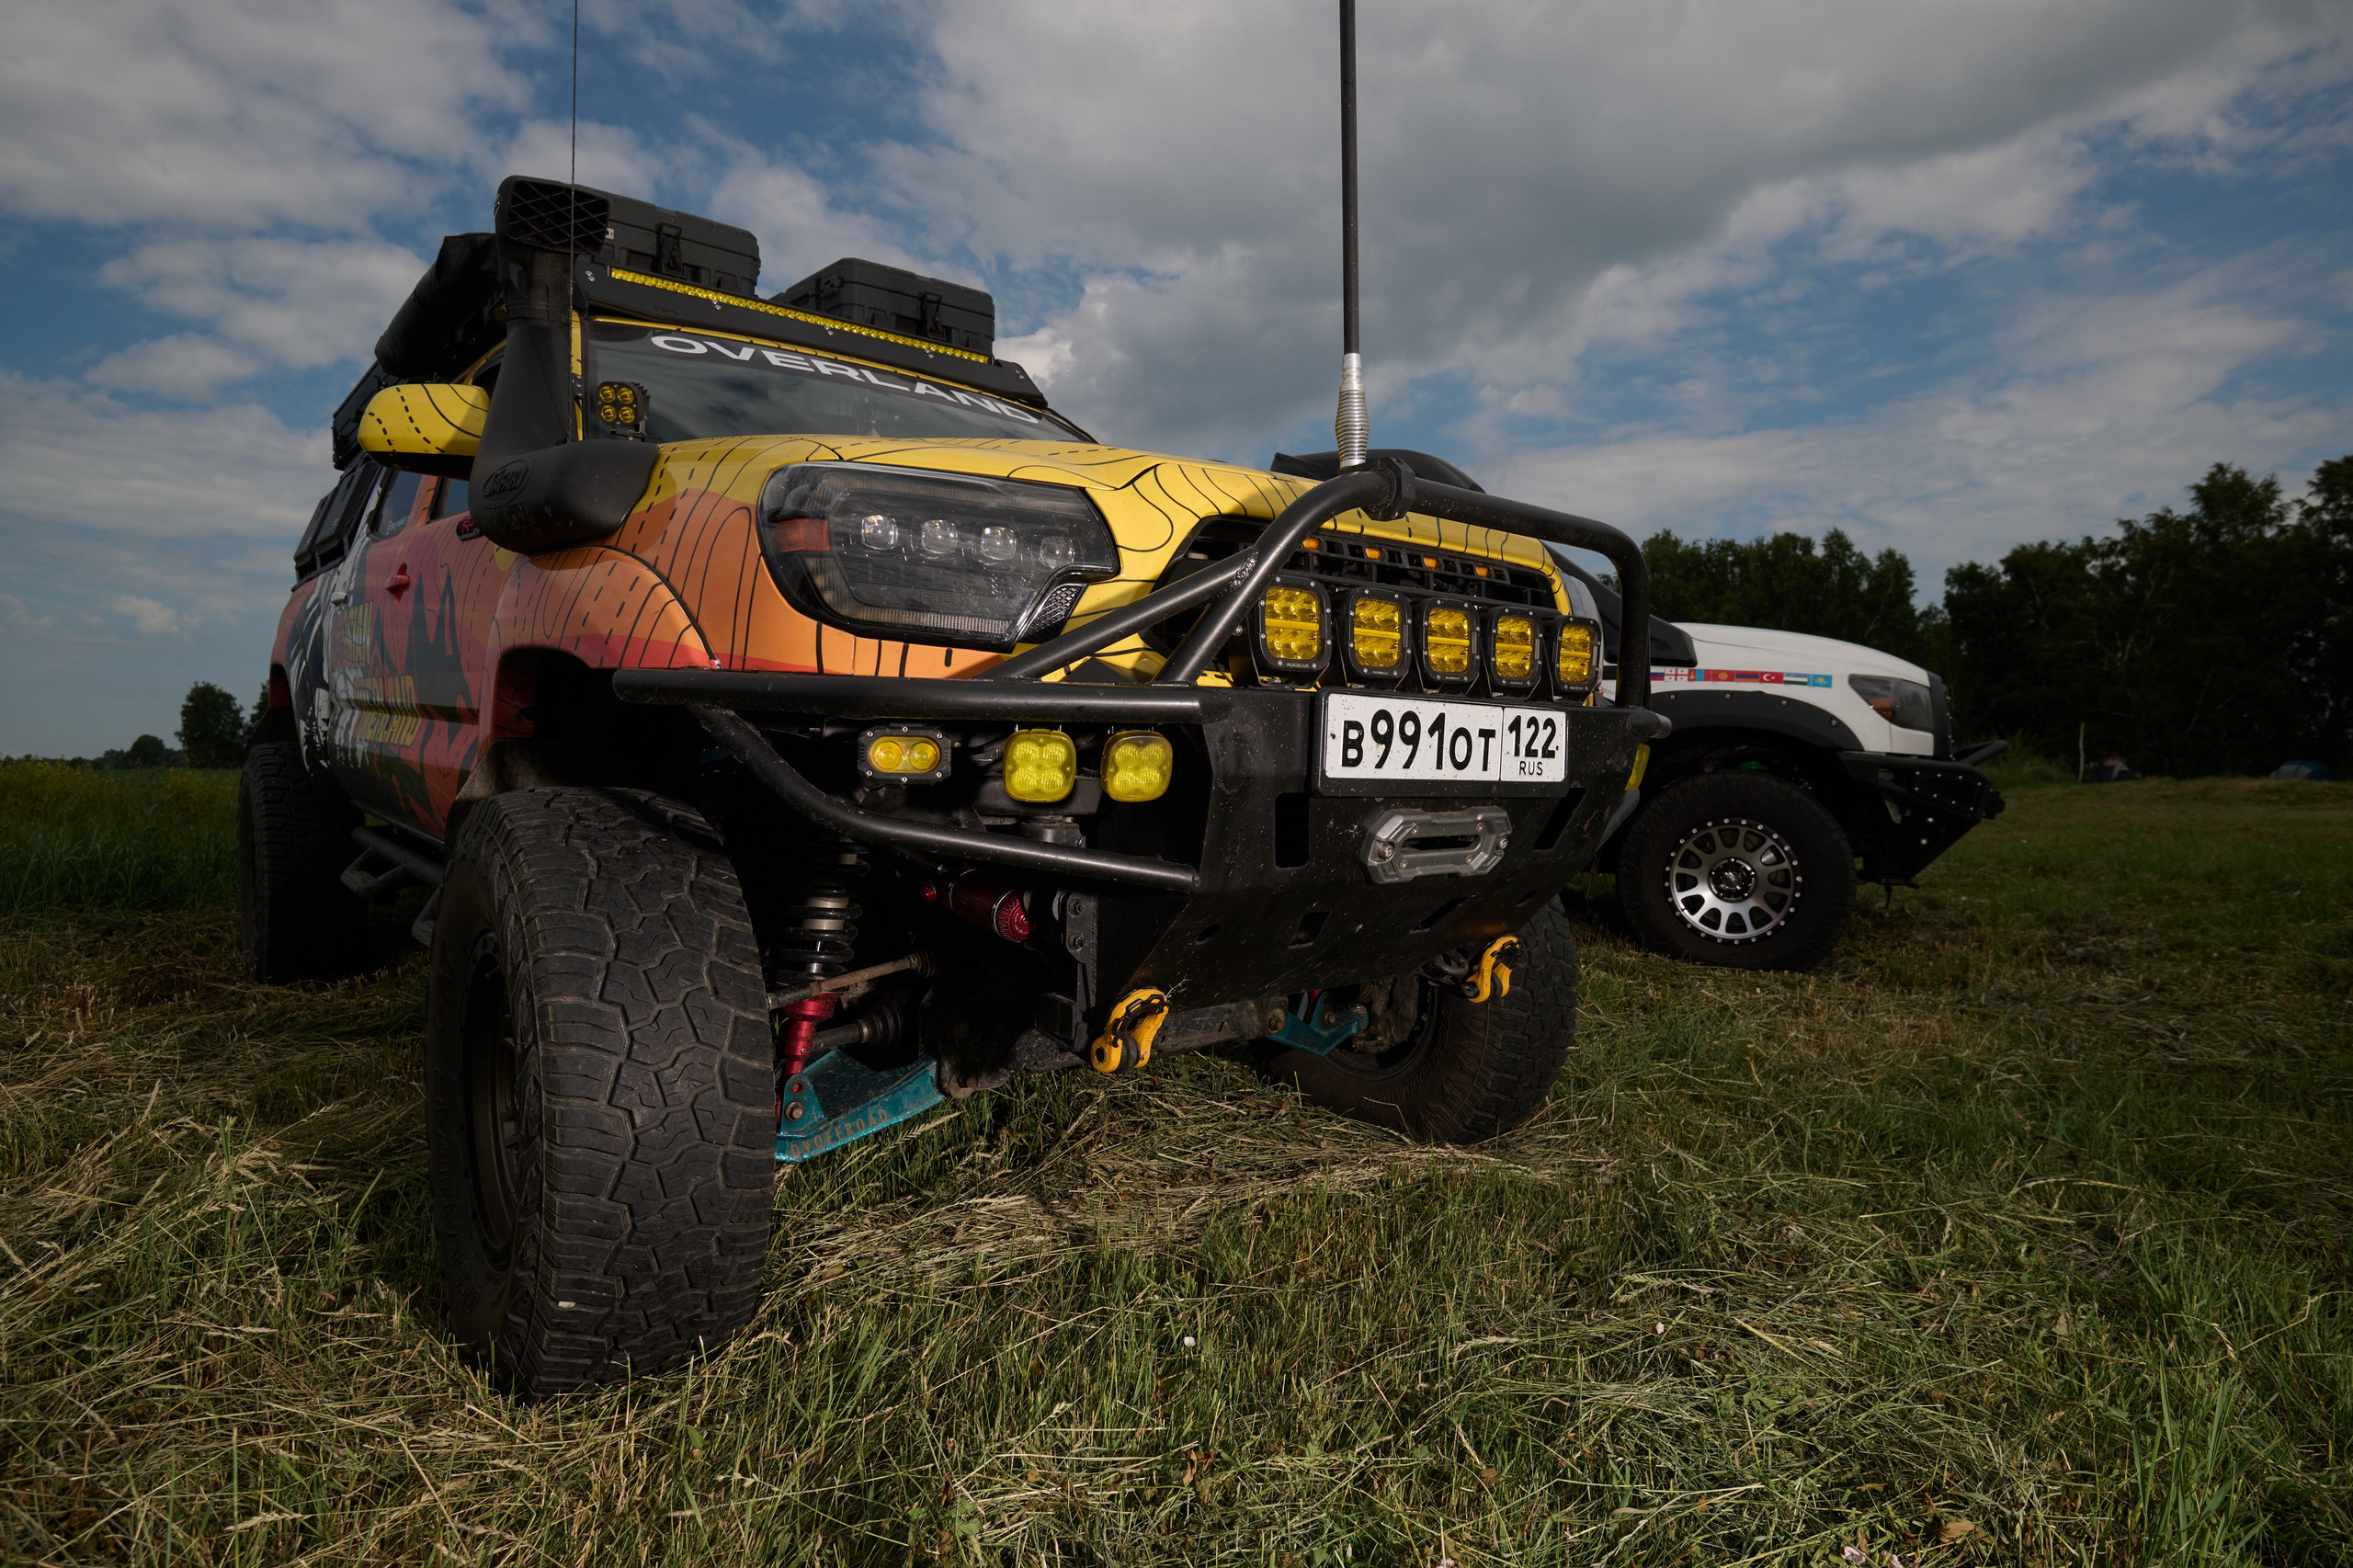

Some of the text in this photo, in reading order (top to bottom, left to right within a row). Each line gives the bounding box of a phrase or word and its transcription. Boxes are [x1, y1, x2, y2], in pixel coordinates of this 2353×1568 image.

[651, 335, 1040, 424] OVERLAND
[483, 467, 529, 497] SAFARI
[1507, 714, 1558, 759] 122
[1518, 760, 1543, 777] RUS
